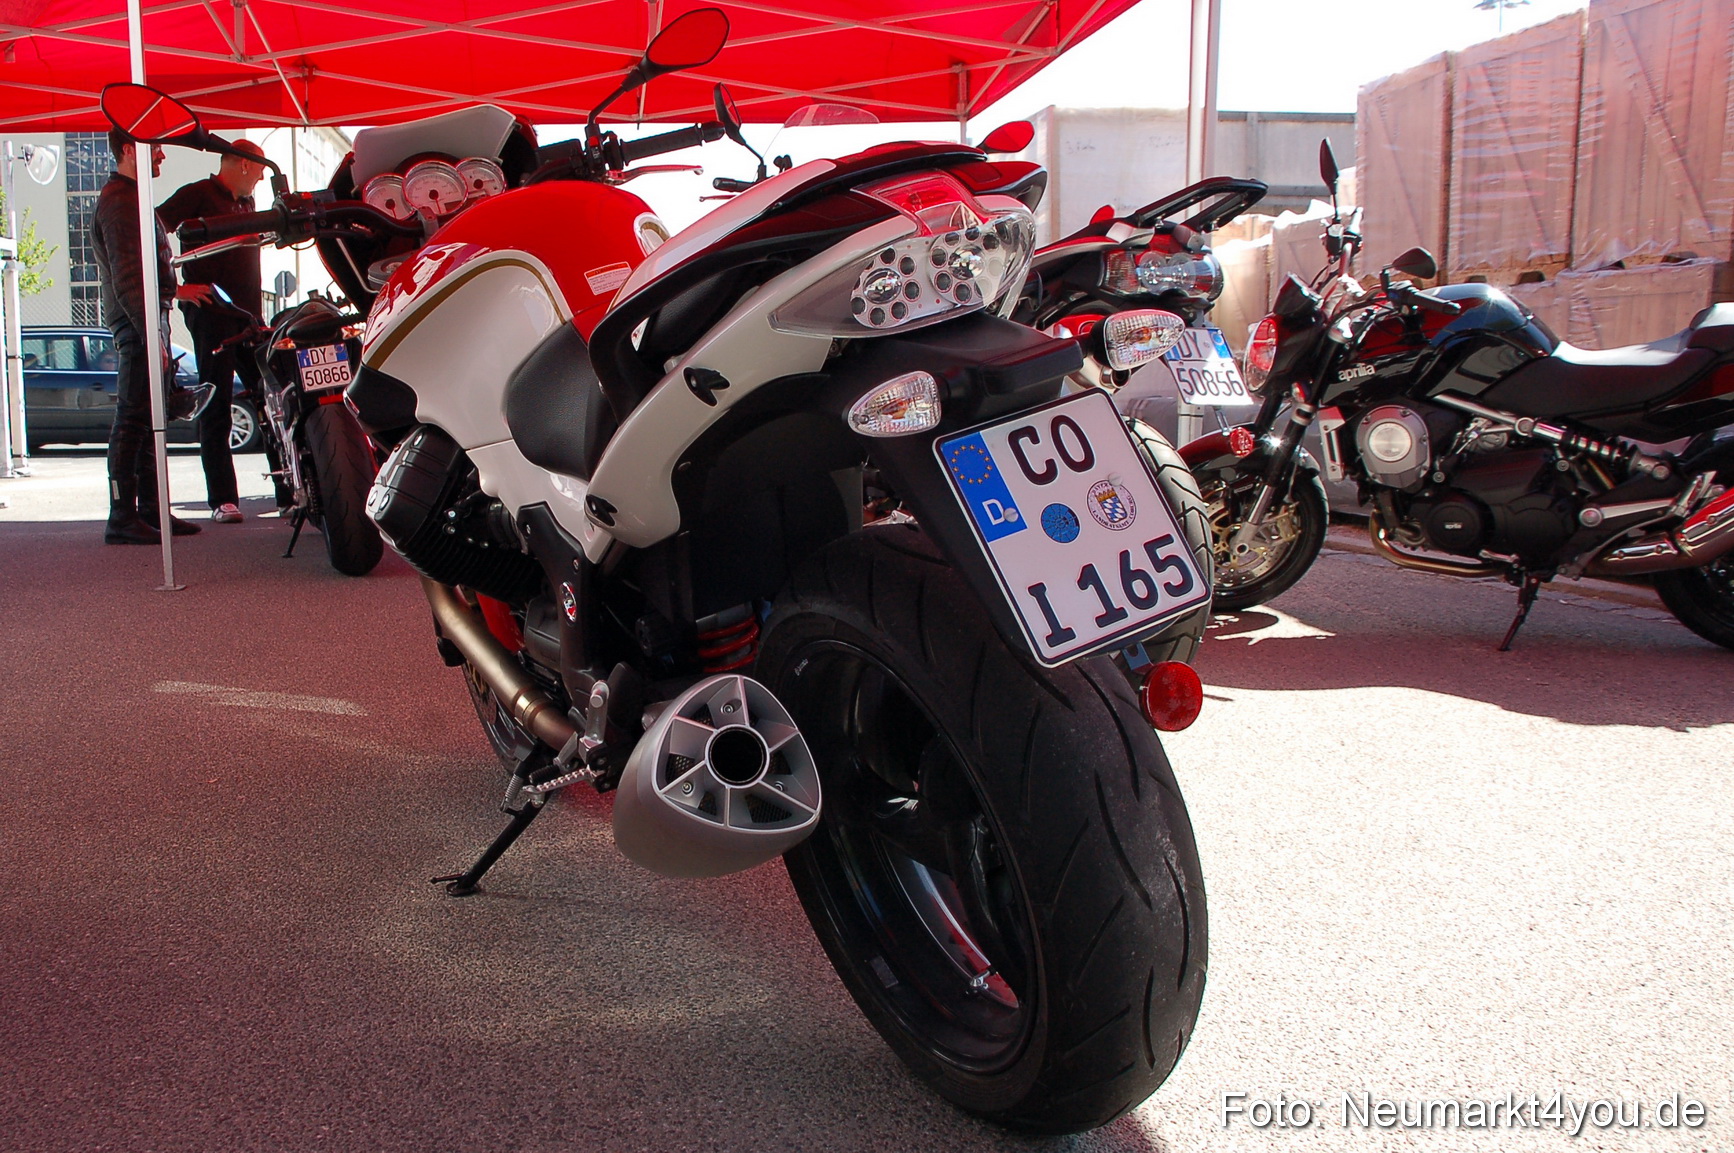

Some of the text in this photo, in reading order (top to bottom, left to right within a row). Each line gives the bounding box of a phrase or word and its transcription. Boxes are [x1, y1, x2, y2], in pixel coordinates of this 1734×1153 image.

[310, 347, 327, 365] DY
[305, 365, 350, 387] 50866
[1176, 367, 1245, 397] 50856
[1338, 363, 1376, 382] aprilia
[1007, 414, 1095, 486] CO
[982, 498, 1006, 526] D
[1027, 533, 1194, 648] I 165
